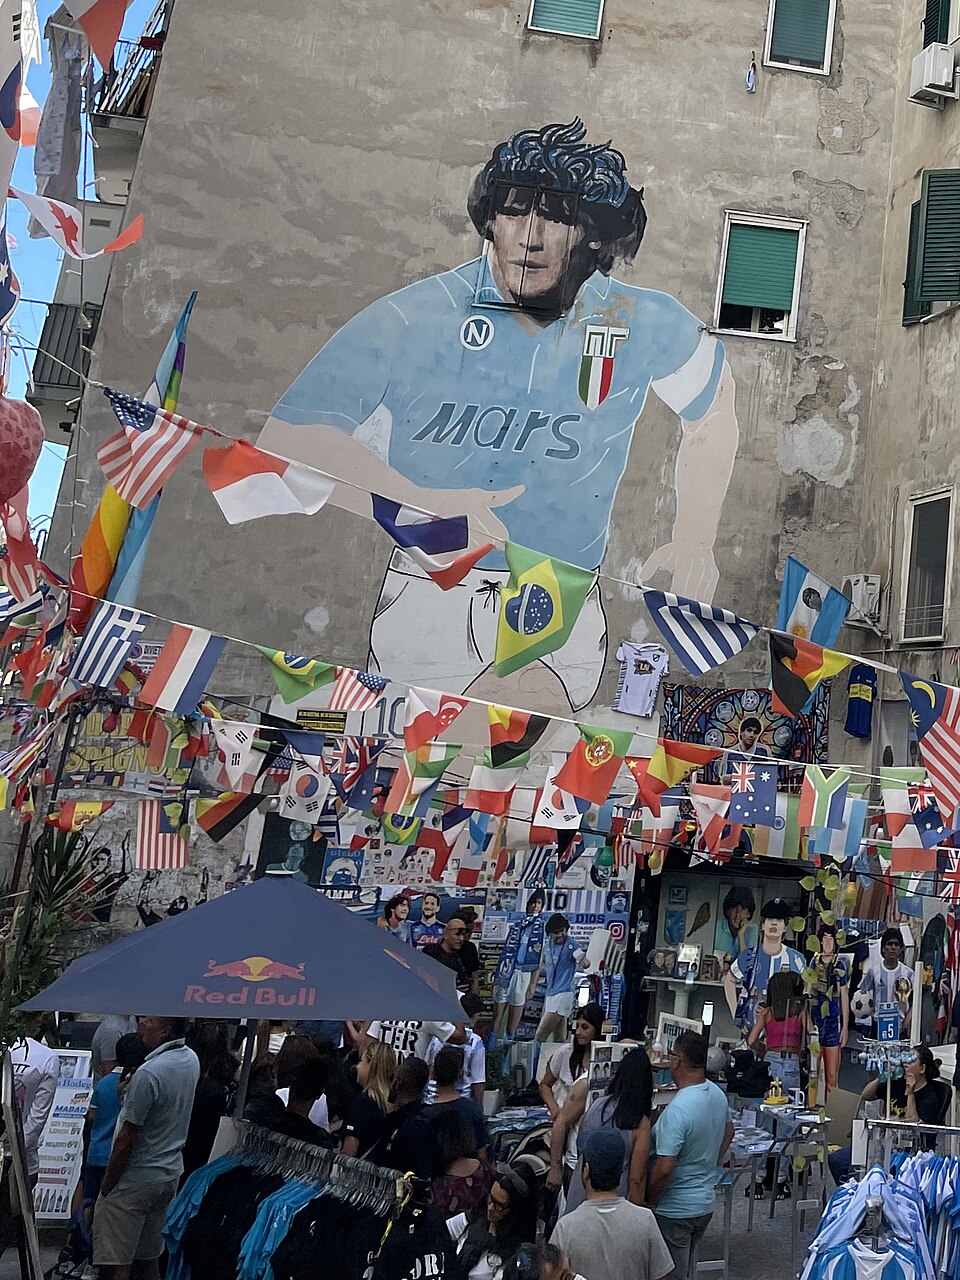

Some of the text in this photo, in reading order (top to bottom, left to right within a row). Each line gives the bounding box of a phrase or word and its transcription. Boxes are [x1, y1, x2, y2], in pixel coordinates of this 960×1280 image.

[410, 402, 581, 460] Mars
[64, 745, 168, 776] SPAGN
[575, 914, 606, 924] DIOS
[184, 984, 317, 1006] Red Bull
